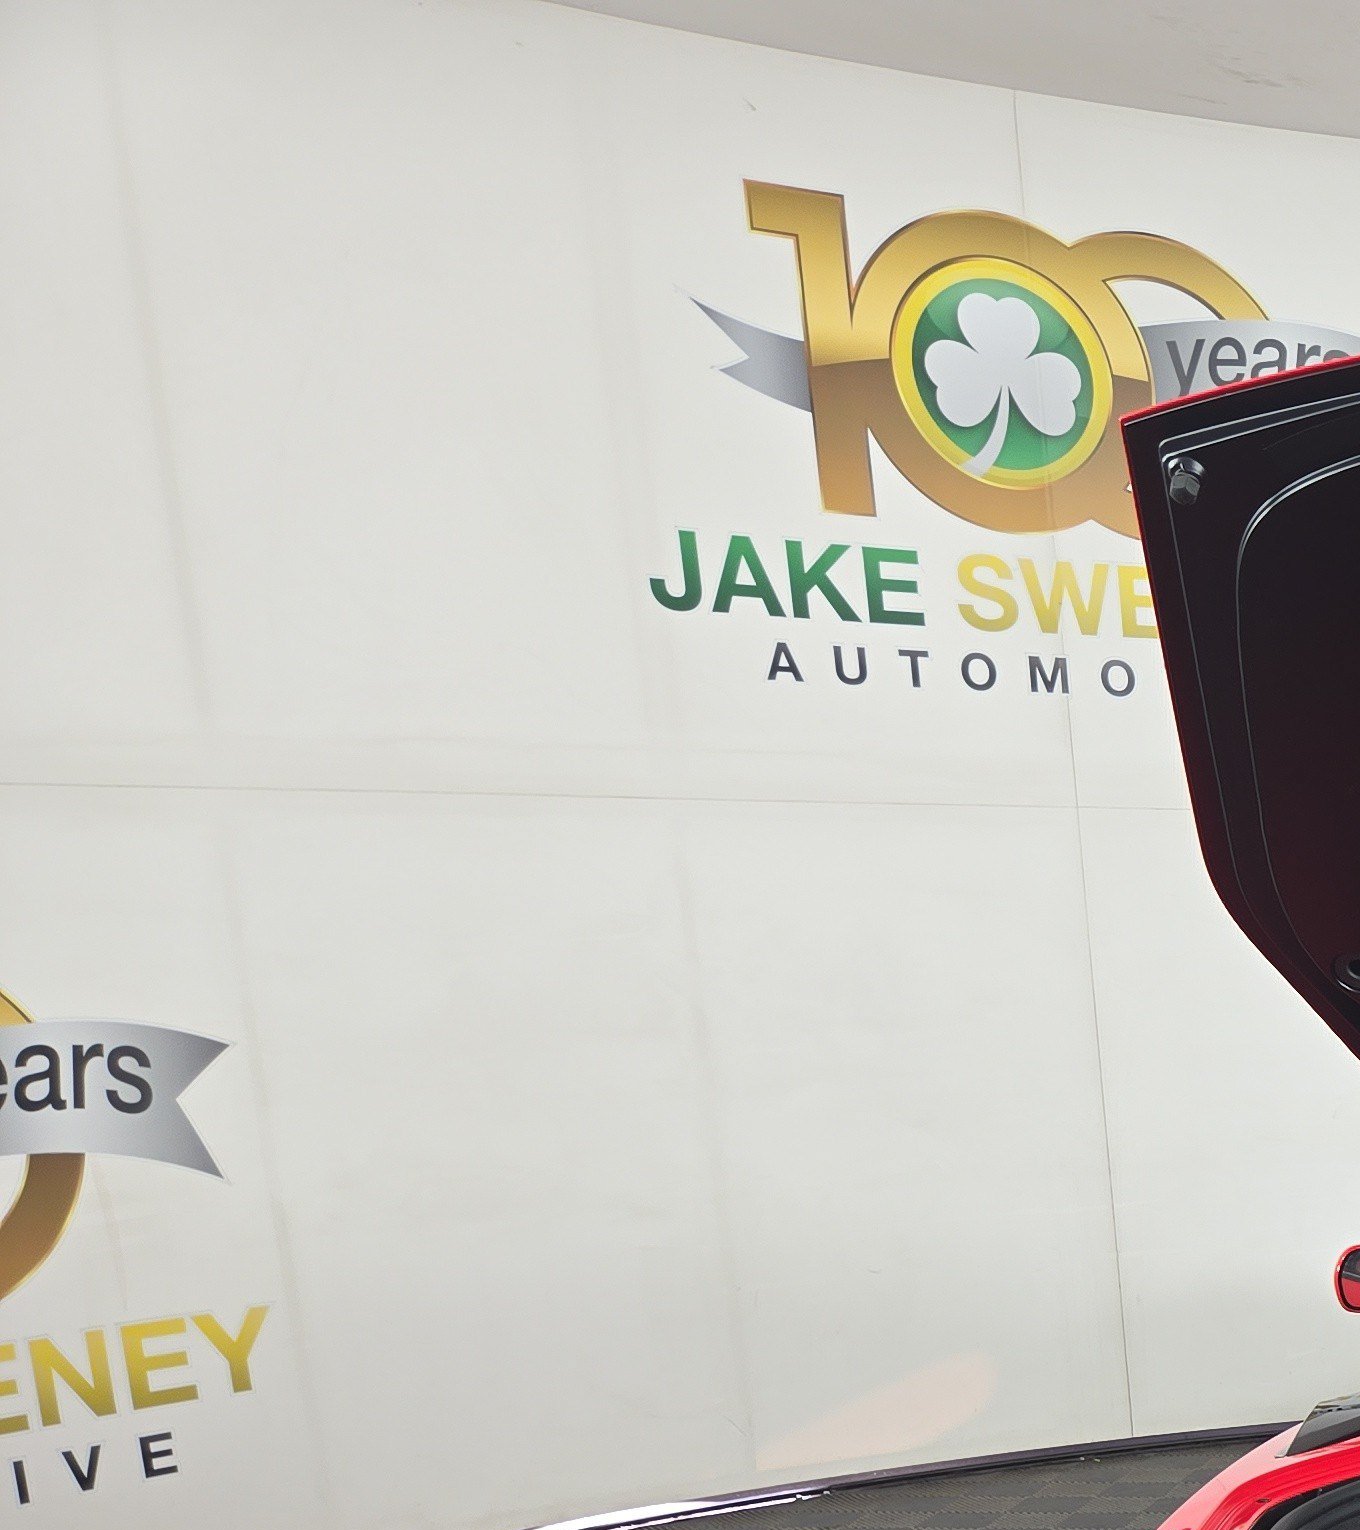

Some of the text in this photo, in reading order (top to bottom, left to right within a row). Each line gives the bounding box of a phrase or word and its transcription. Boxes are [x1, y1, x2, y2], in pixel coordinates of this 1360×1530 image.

[649, 529, 926, 626] JAKE
[767, 642, 1135, 697] AUTOMO
[0, 1044, 153, 1114] ars
[13, 1432, 178, 1504] IVE
